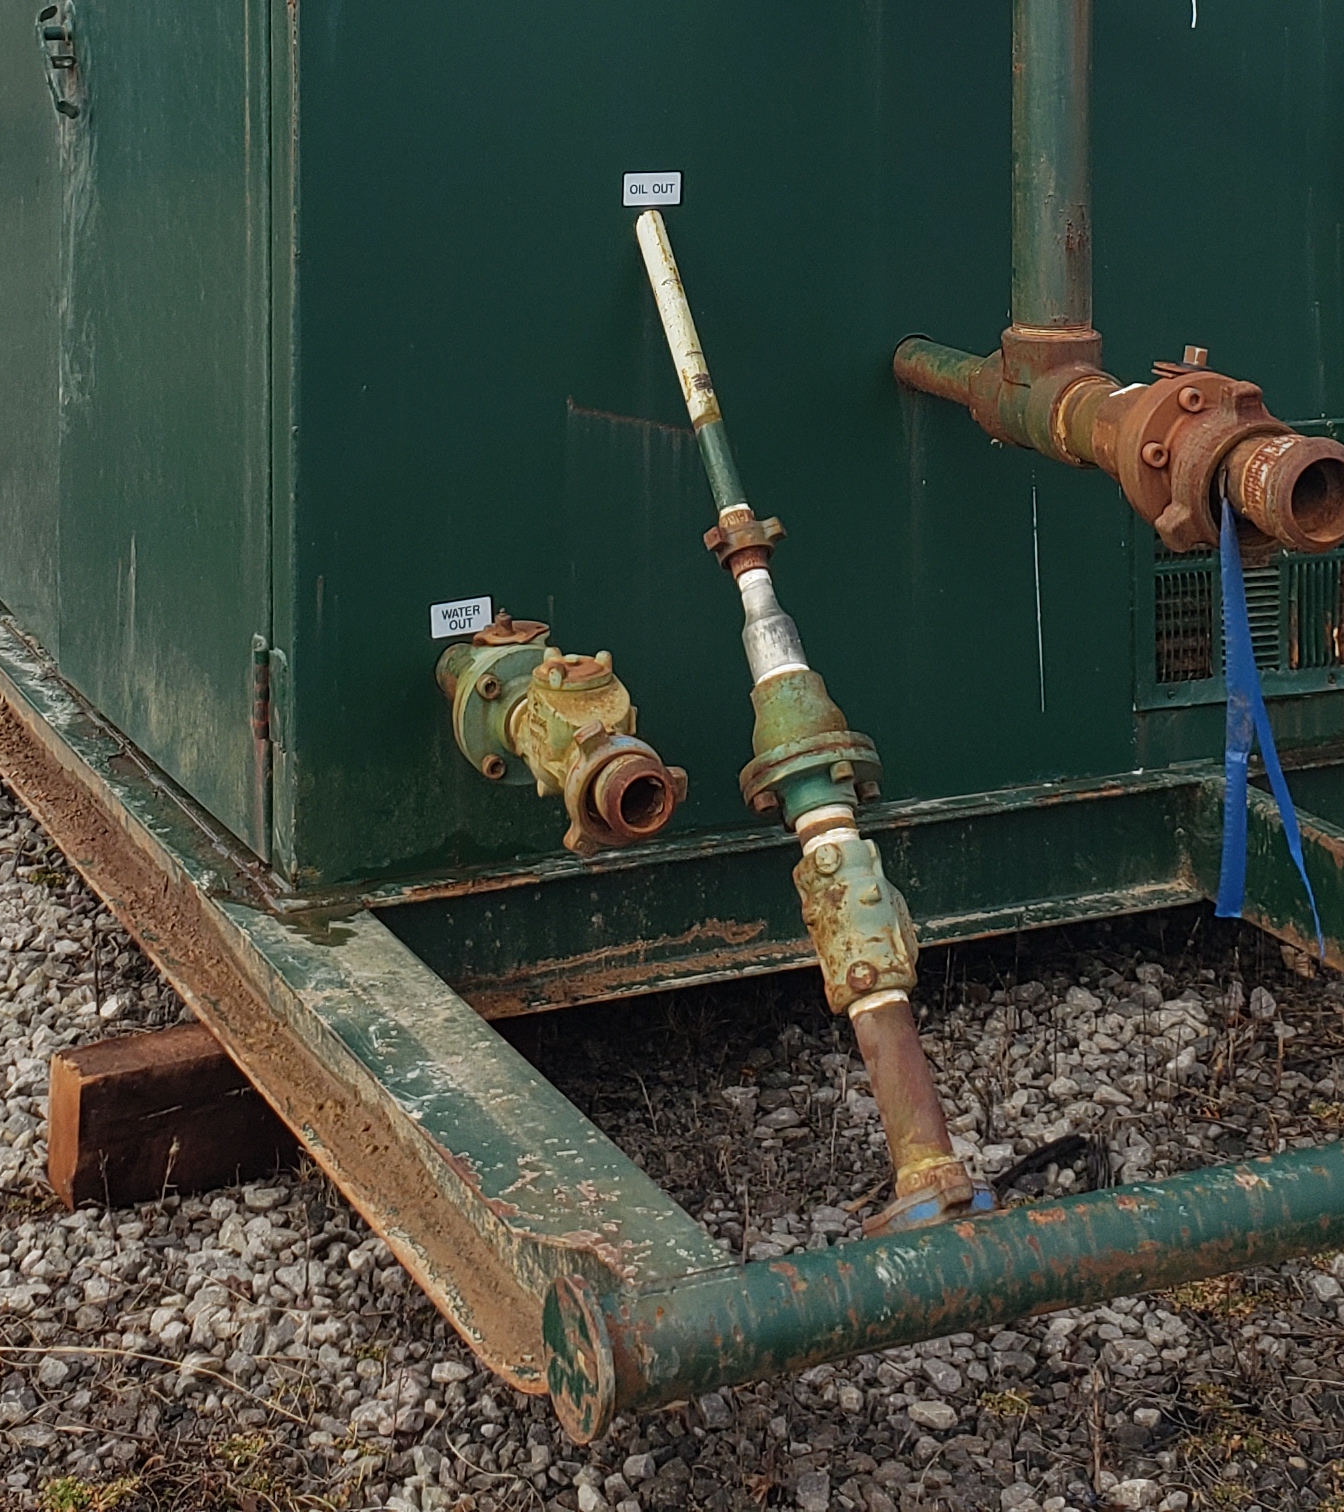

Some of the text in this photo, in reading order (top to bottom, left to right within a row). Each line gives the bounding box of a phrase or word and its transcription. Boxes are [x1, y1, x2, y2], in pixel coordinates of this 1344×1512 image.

[629, 183, 675, 195] OIL OUT
[441, 604, 481, 620] WATER
[449, 617, 473, 630] OUT
